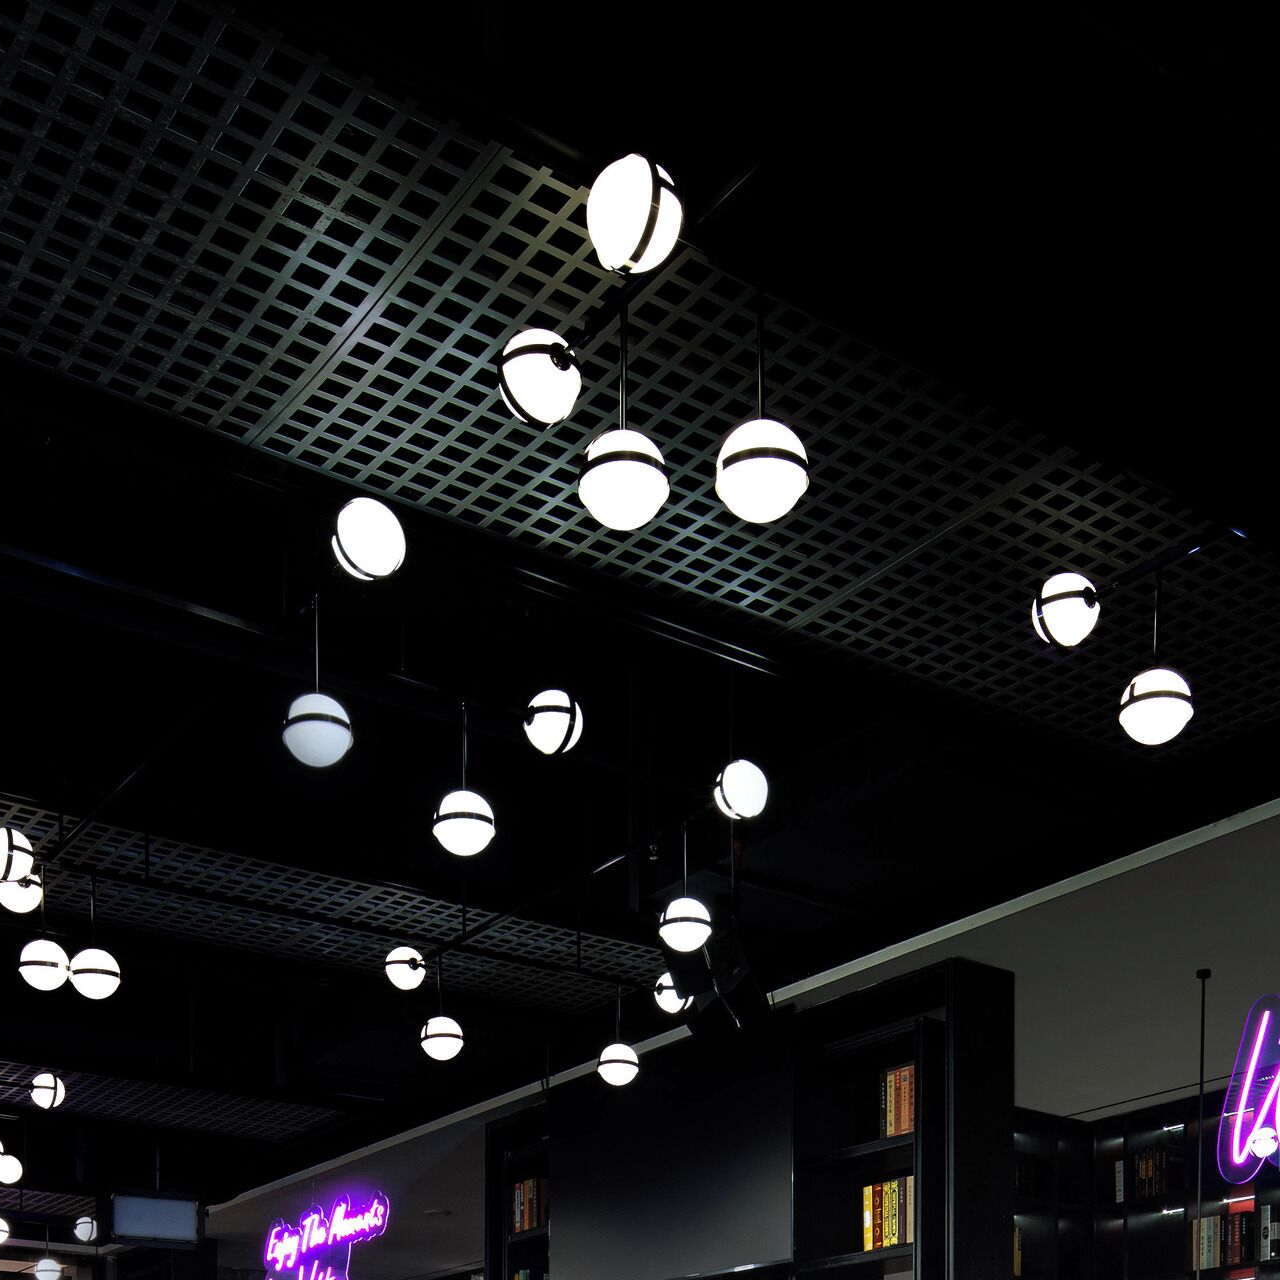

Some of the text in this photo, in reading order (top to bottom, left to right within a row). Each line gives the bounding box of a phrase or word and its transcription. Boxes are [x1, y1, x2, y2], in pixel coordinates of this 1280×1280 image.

[266, 1198, 386, 1272] Enjoy The Moments
